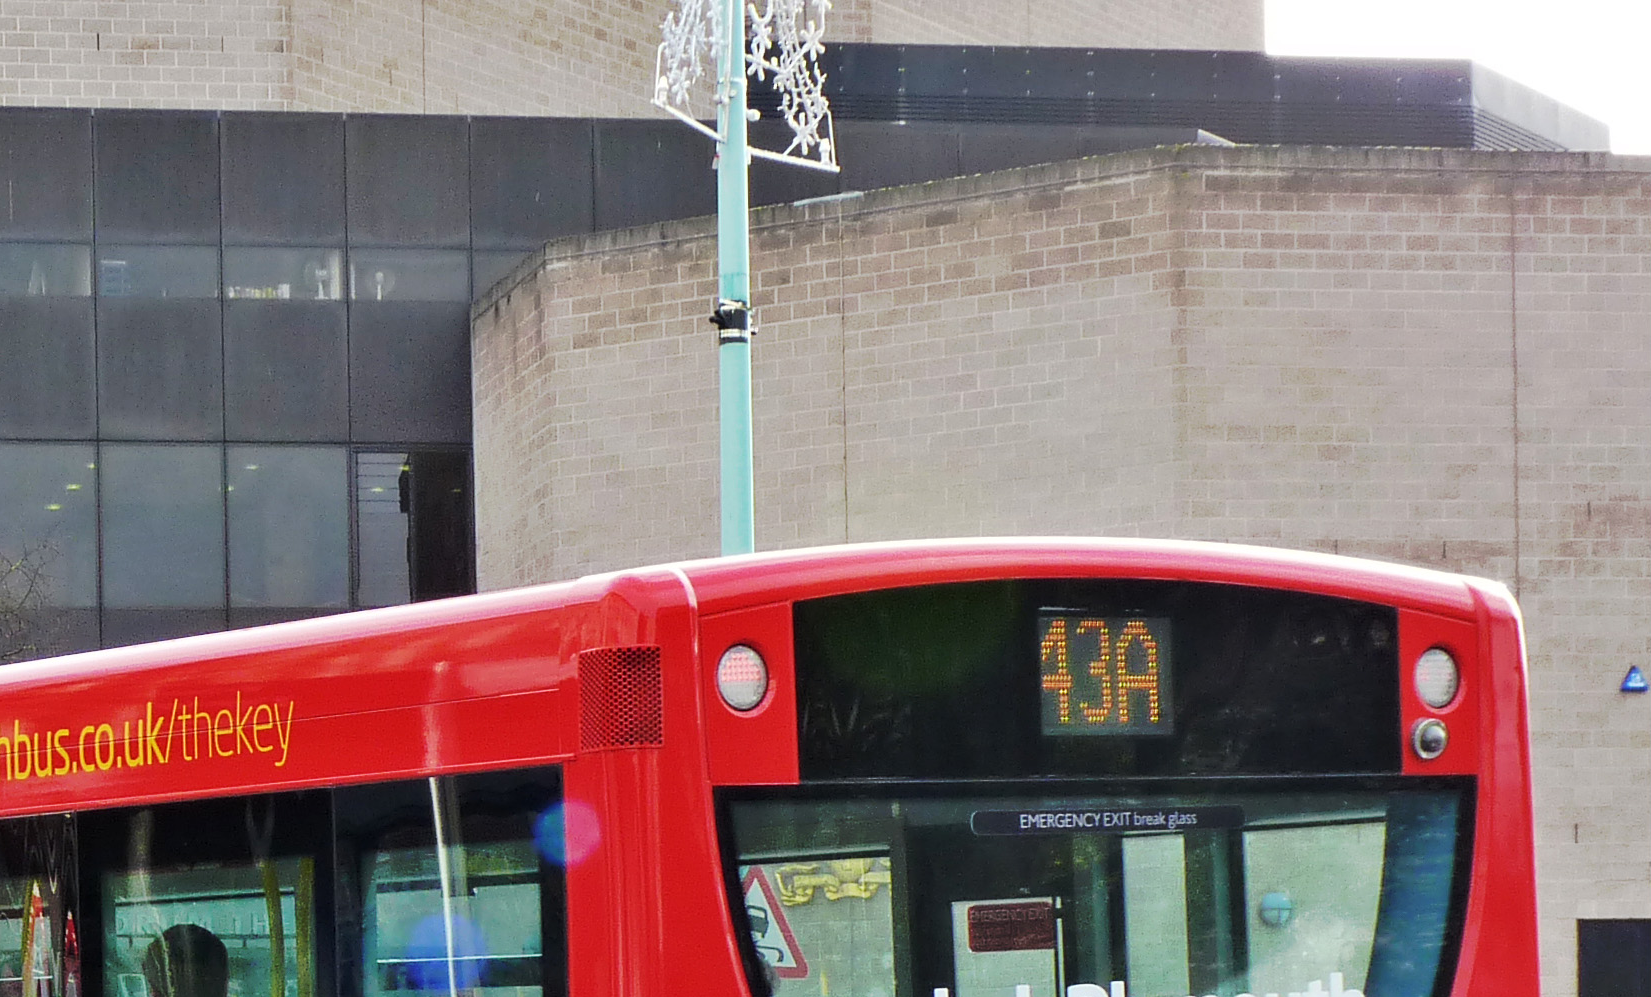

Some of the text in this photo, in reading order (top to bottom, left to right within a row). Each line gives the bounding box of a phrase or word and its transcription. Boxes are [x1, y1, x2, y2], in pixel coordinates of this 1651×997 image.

[1041, 618, 1160, 723] 43A
[1019, 812, 1197, 829] EMERGENCY EXIT break glass
